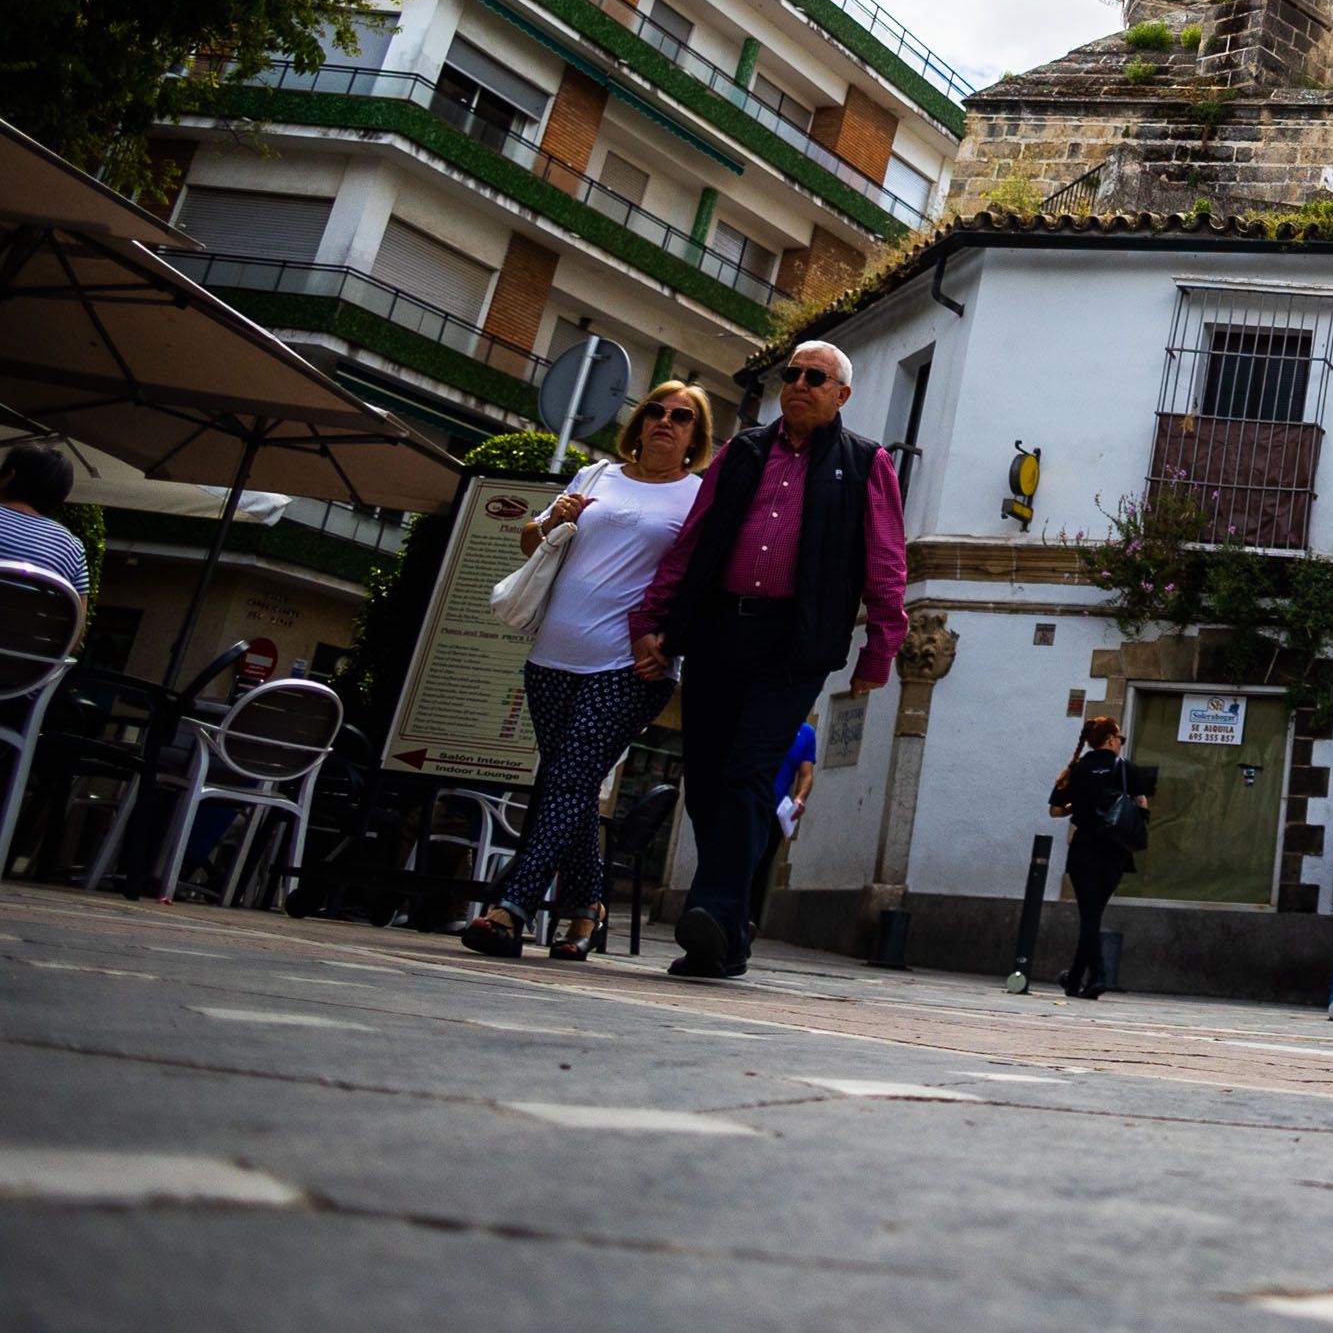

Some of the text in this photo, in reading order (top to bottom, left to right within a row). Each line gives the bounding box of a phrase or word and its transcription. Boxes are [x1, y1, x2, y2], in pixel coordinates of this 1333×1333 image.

[1191, 724, 1234, 734] SE ALQUILA
[439, 752, 524, 767] Salón Interior
[435, 764, 520, 781] Indoor Lounge
